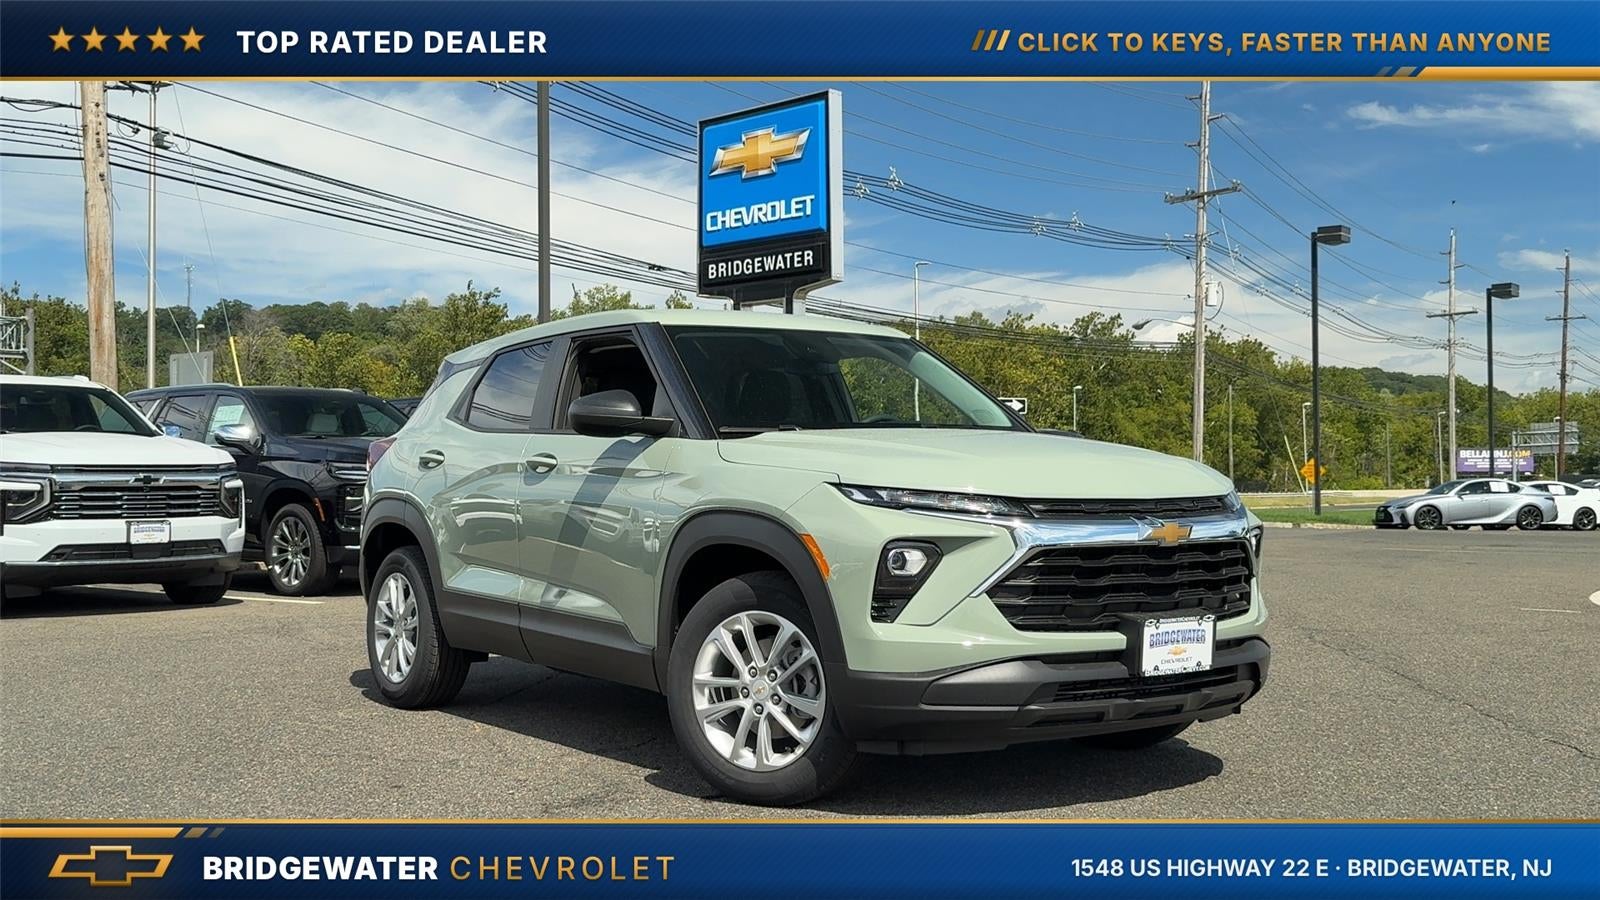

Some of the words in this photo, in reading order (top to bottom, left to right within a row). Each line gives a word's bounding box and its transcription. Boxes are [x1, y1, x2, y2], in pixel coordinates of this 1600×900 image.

[706, 194, 815, 231] CHEVROLET
[708, 250, 814, 279] BRIDGEWATER
[1149, 629, 1206, 647] BRIDGEWATER
